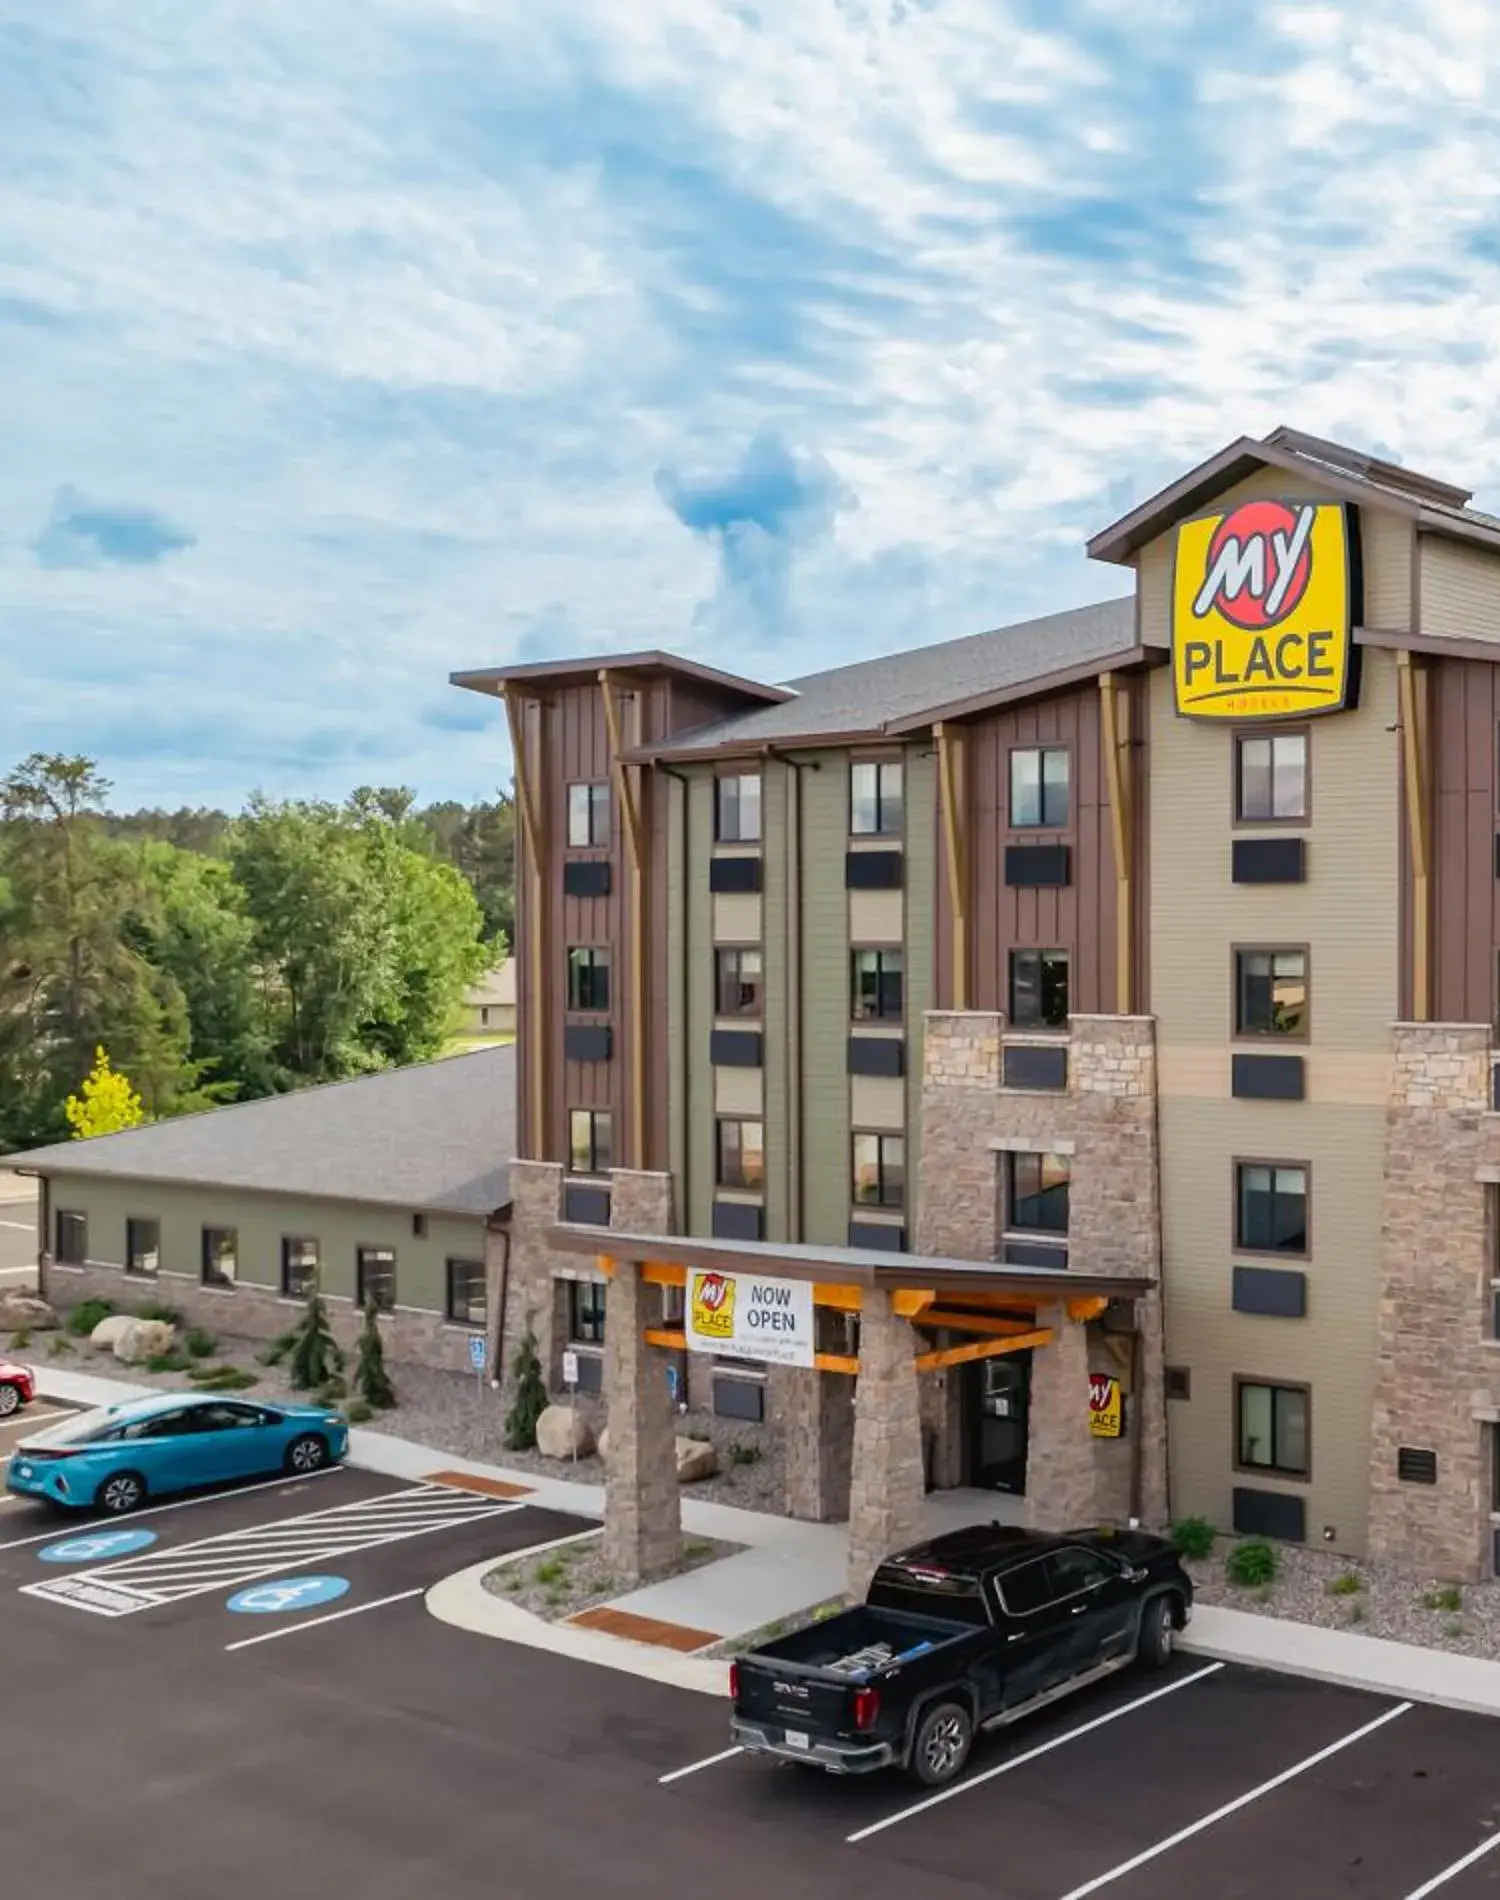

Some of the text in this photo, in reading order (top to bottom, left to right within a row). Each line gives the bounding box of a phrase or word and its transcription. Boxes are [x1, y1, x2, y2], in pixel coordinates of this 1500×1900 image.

[1193, 503, 1316, 618] MY
[1184, 630, 1335, 687] PLACE
[751, 1285, 791, 1307] NOW
[693, 1310, 731, 1329] PLACE
[747, 1309, 796, 1332] OPEN
